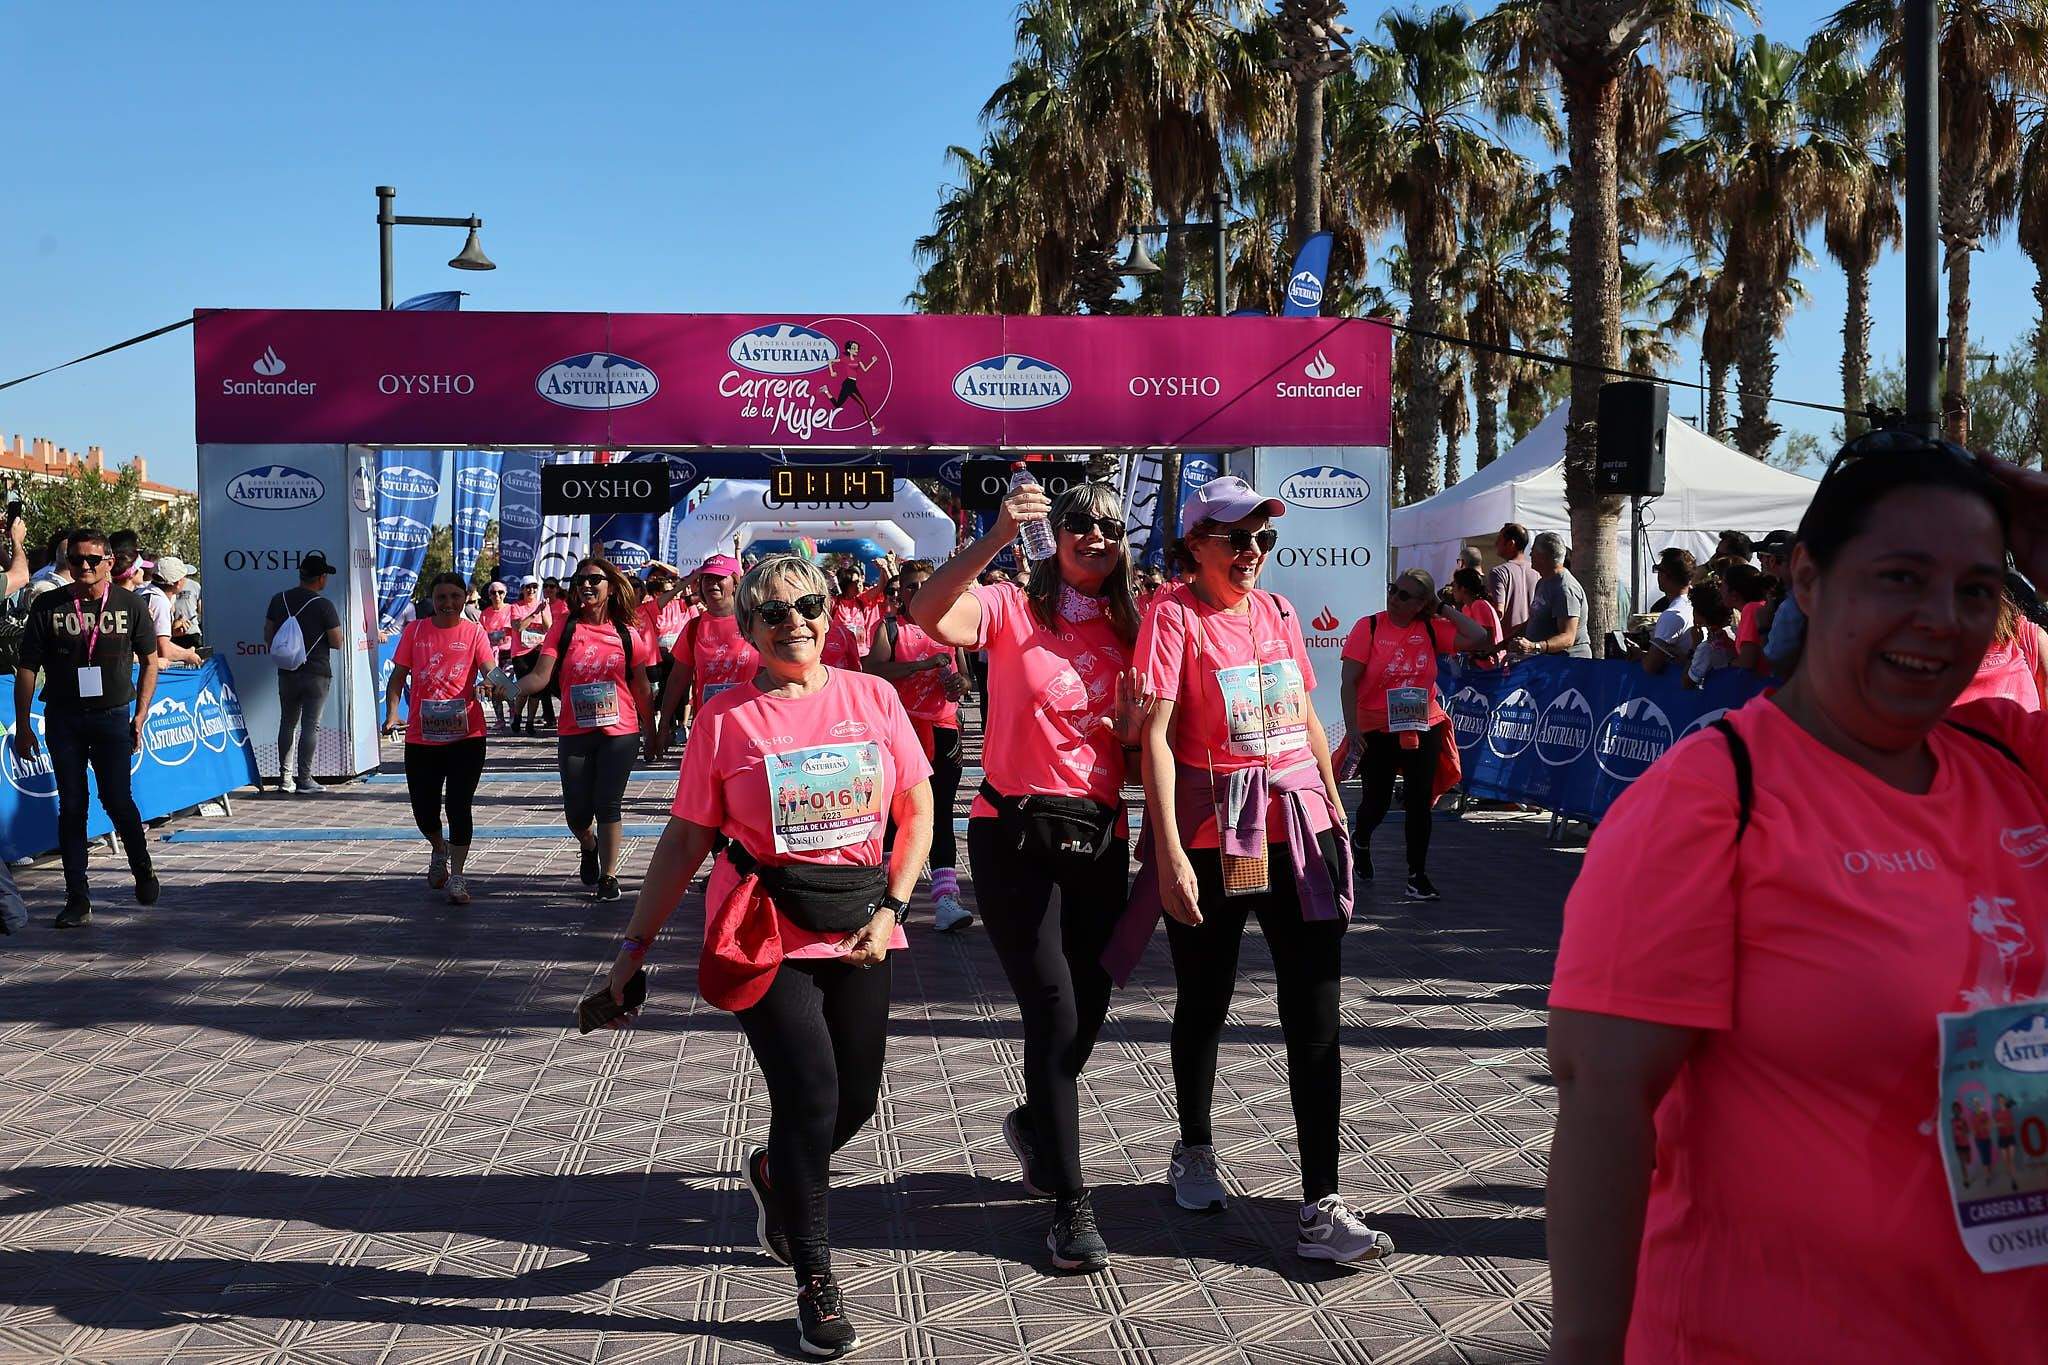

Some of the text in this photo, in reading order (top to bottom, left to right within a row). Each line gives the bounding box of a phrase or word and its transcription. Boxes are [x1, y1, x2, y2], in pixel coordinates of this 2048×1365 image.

[737, 341, 830, 362] ASTURIANA
[223, 379, 317, 395] Santander
[378, 374, 475, 395] OYSHO
[545, 373, 650, 395] ASTURIANA
[718, 370, 810, 399] Carrera
[962, 375, 1062, 396] ASTURIANA
[1129, 376, 1220, 396] OYSHO
[1276, 382, 1363, 398] Santander
[741, 395, 844, 440] de la Mujer
[233, 482, 318, 499] ASTURIANA
[379, 475, 434, 495] ASTURIANA
[562, 479, 652, 499] OYSHO
[778, 471, 885, 496] 01:11:47
[1286, 482, 1363, 499] ASTURIANA
[682, 558, 703, 566] OYSH
[1277, 547, 1371, 567] OYSHO
[1303, 635, 1348, 648] ntand
[1265, 720, 1280, 729] 221
[1453, 714, 1484, 734] STURIANA
[1492, 720, 1533, 741] ASTURIANA
[148, 726, 193, 750] ASTURIANA
[1538, 724, 1585, 749] ASTURIANA
[1599, 722, 1664, 762] ASTURIANA
[10, 748, 54, 780] ASTUR
[805, 760, 847, 771] ASTURIANA
[821, 811, 841, 820] 4223
[781, 825, 809, 833] CARRERA
[830, 820, 848, 829] MUJER
[788, 836, 824, 846] OYSHO
[1061, 840, 1093, 853] FILA
[1969, 1199, 2025, 1221] CARRERA
